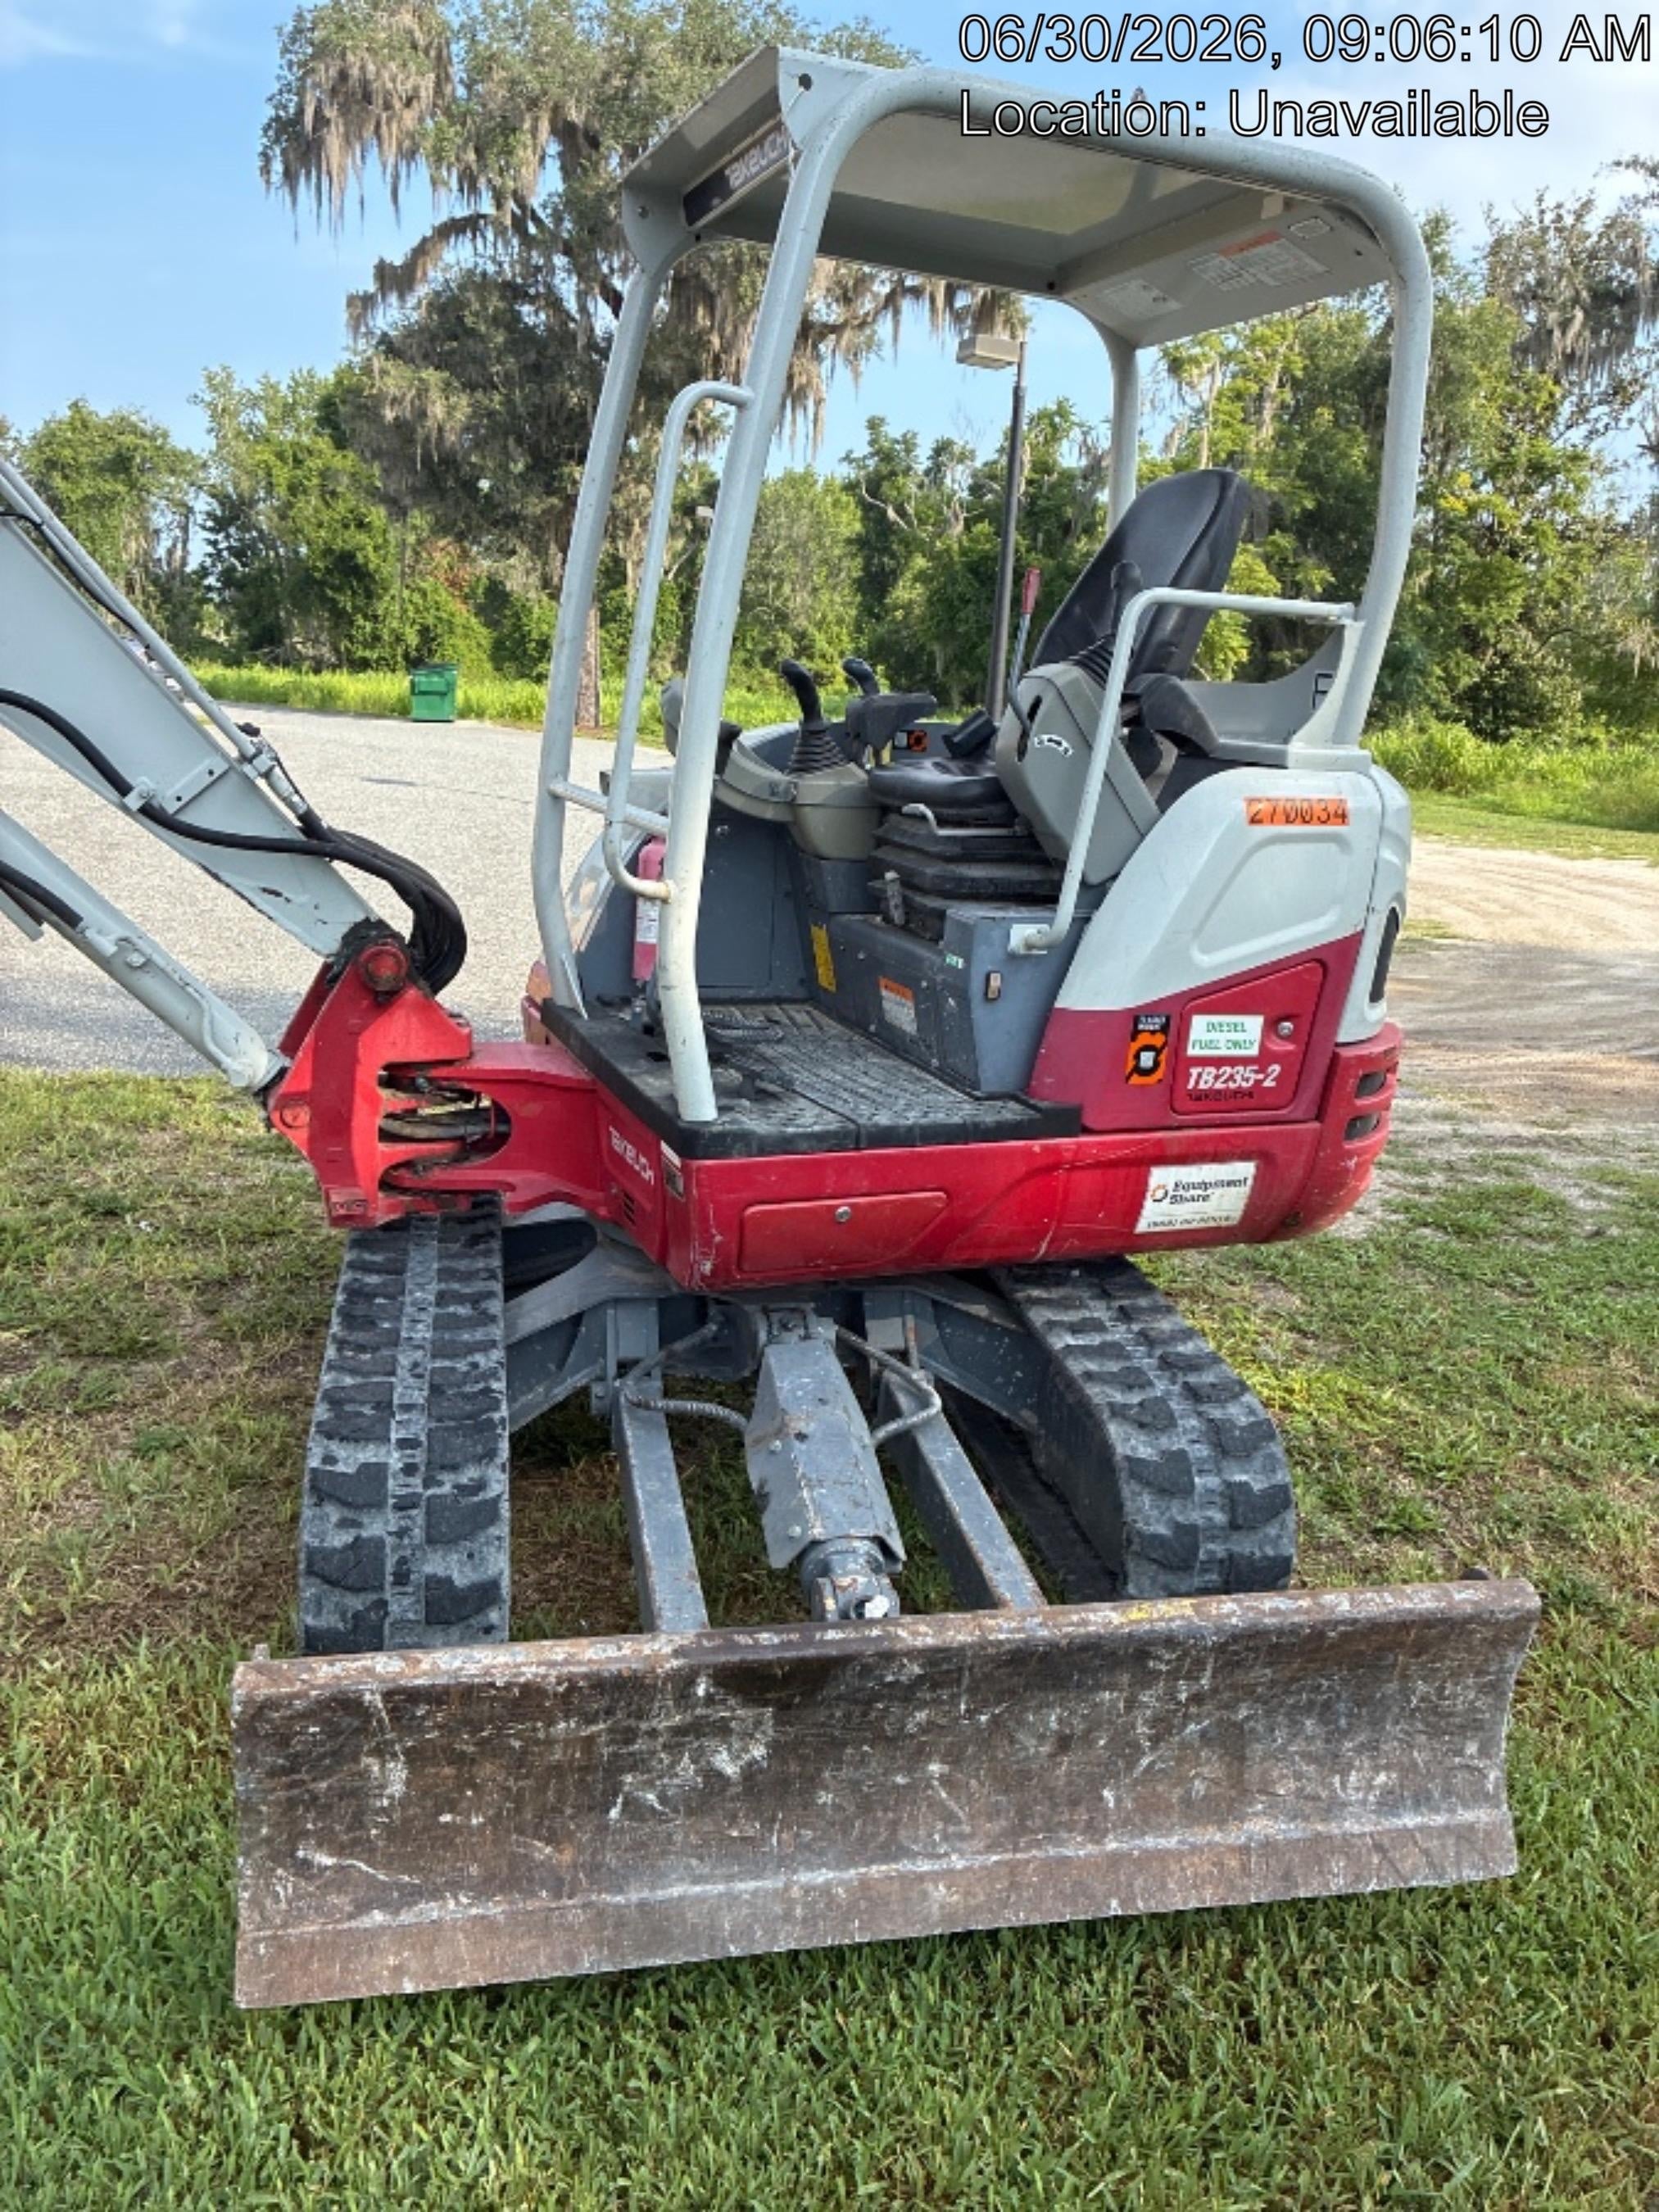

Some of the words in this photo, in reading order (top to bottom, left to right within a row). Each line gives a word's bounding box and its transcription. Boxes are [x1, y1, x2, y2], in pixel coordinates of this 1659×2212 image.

[1249, 798, 1348, 824] 270034
[1206, 1022, 1247, 1033] DIESEL
[1192, 1039, 1221, 1050] FUEL
[1224, 1039, 1256, 1050] ONLY
[1187, 1063, 1281, 1090] TB235-2
[1172, 1176, 1249, 1193] Equipment
[1169, 1191, 1211, 1205] Share
